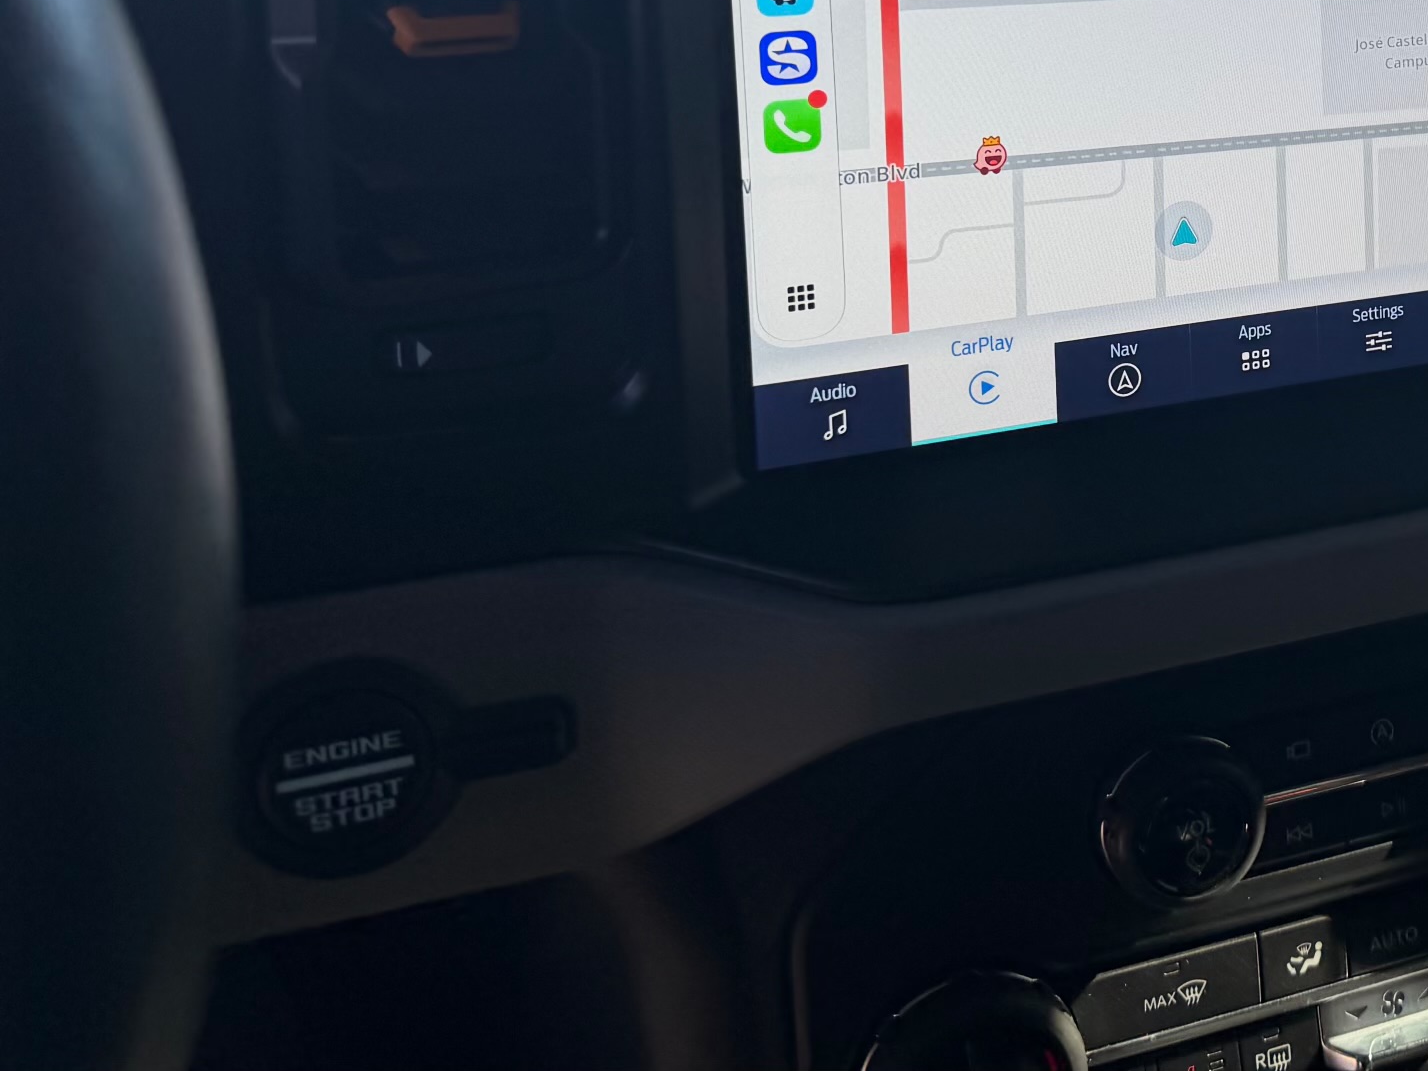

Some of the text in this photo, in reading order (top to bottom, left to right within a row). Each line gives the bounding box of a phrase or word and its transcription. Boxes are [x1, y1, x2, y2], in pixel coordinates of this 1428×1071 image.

[1354, 36, 1384, 54] José
[877, 162, 921, 183] Blvd
[1352, 303, 1405, 323] Settings
[1238, 324, 1272, 341] Apps
[950, 335, 1014, 358] CarPlay
[1110, 342, 1139, 359] Nav
[809, 382, 857, 404] Audio
[284, 730, 404, 769] ENGINE
[295, 777, 404, 816] START
[311, 799, 396, 832] STOP
[1369, 926, 1419, 953] AUTO
[1143, 991, 1178, 1013] MAX
[1255, 1052, 1267, 1070] R
